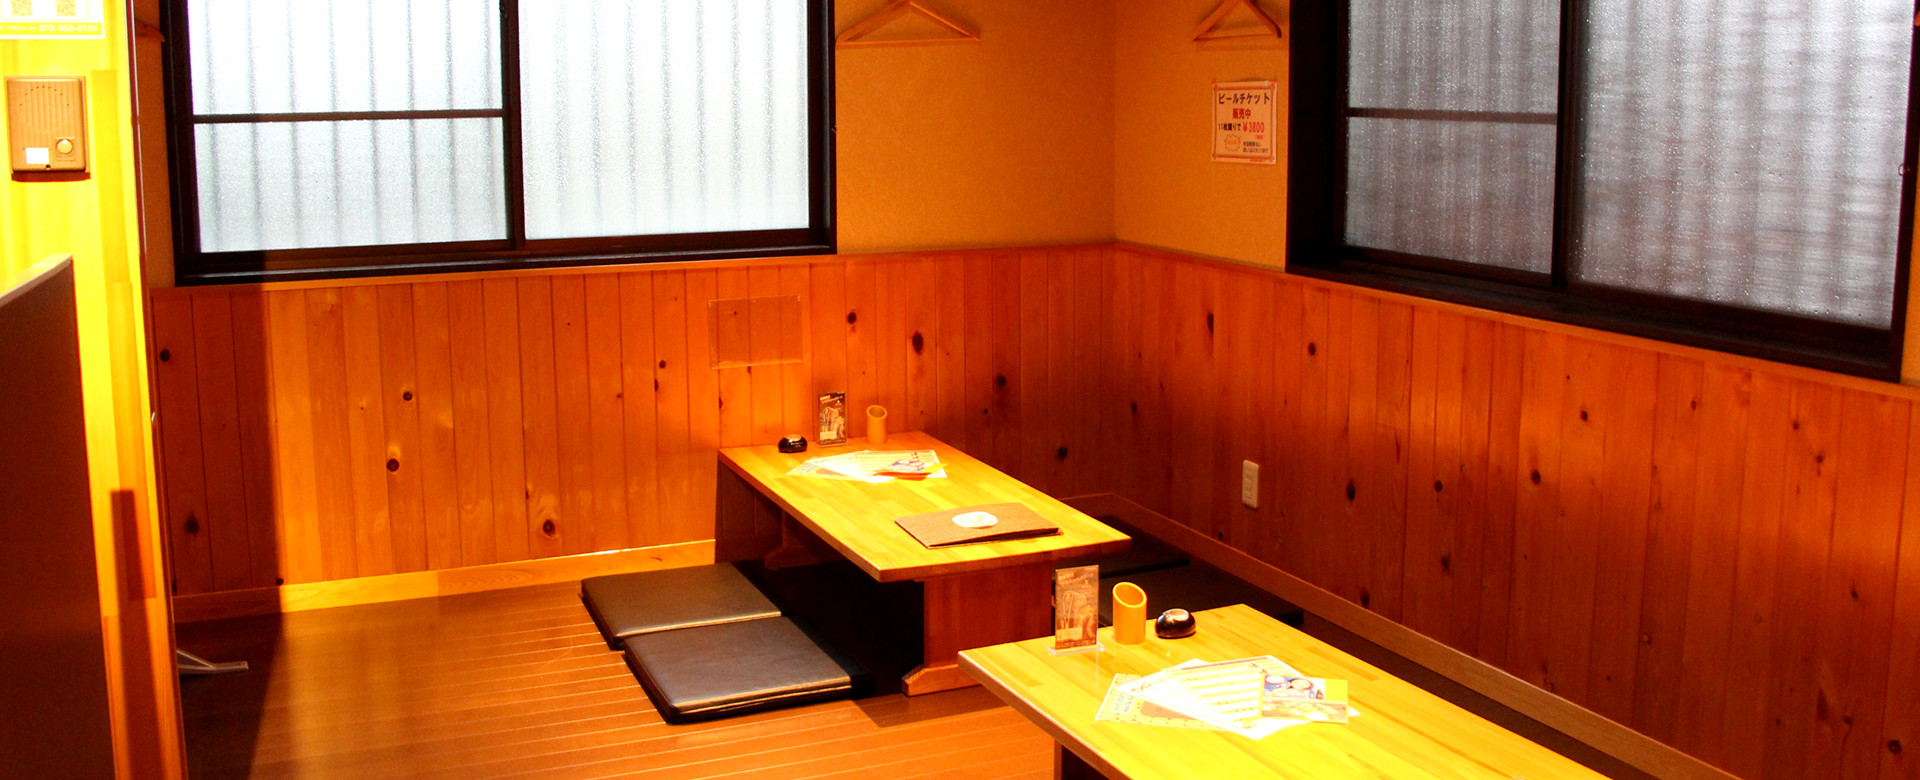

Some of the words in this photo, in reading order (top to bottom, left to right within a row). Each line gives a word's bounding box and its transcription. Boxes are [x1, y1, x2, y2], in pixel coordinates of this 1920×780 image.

[1218, 92, 1270, 104] ビールチケット
[1232, 108, 1251, 119] 販売中
